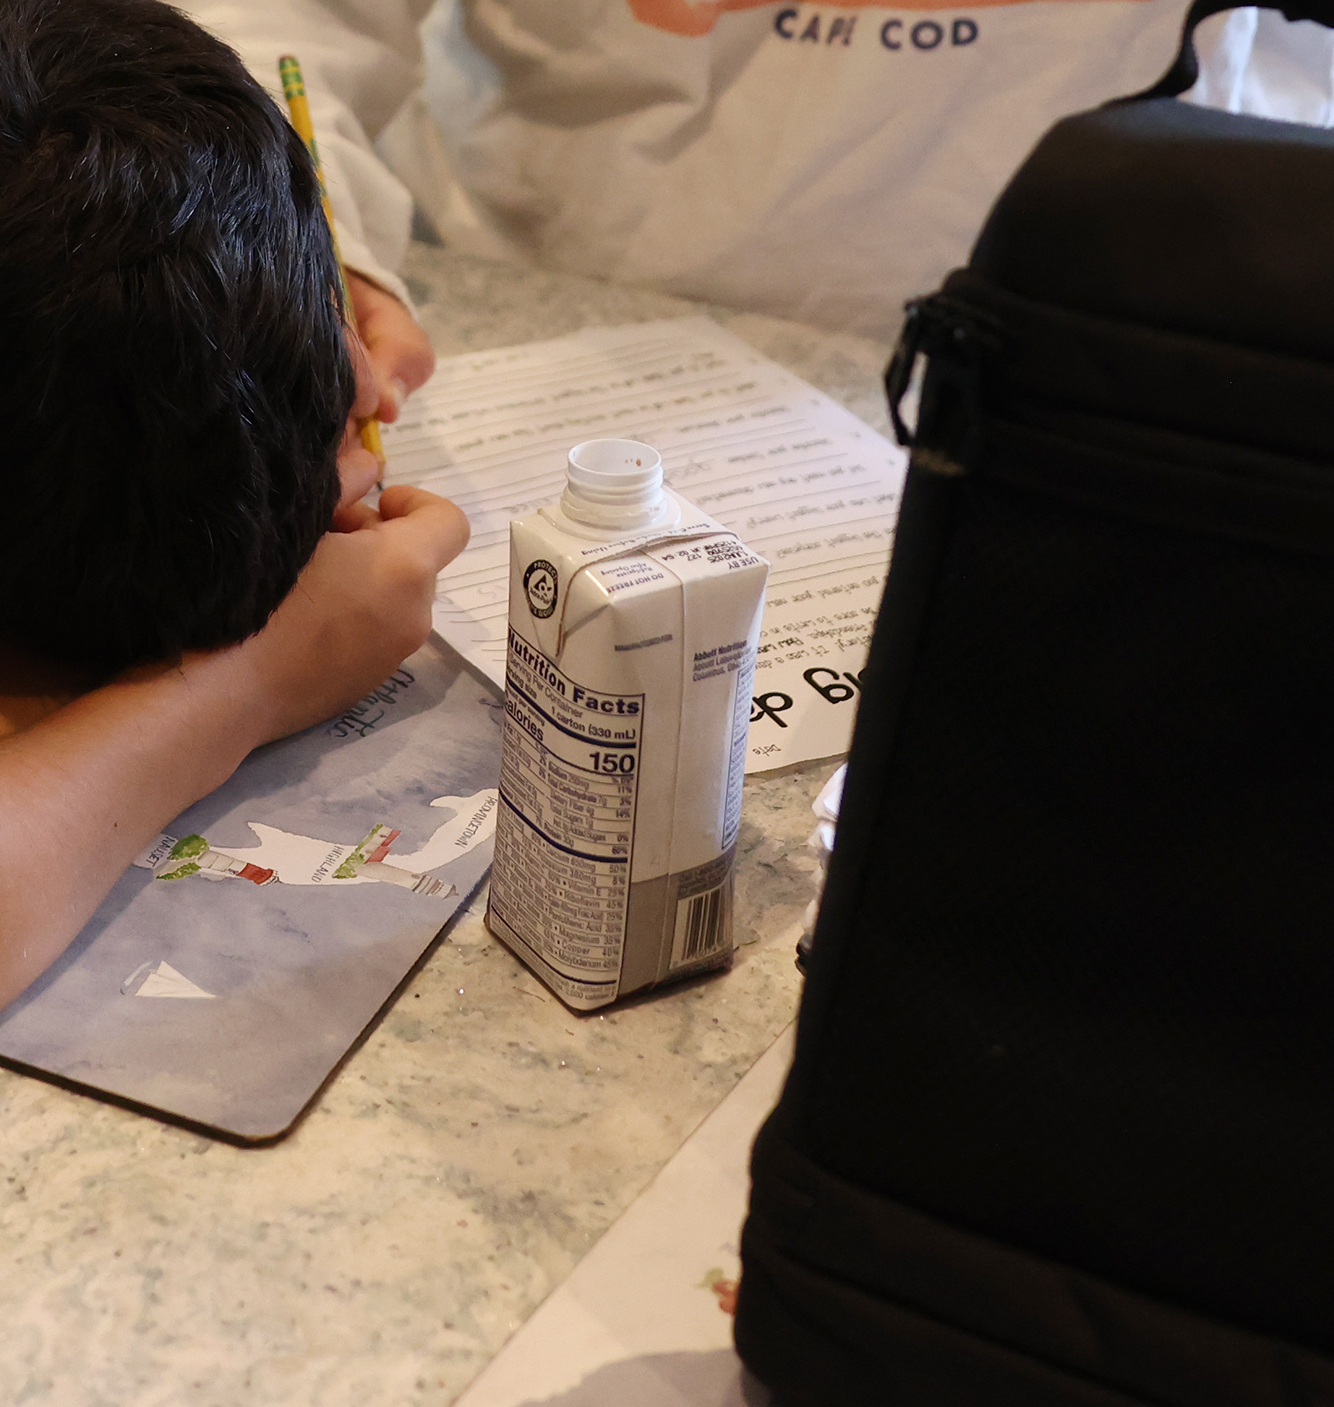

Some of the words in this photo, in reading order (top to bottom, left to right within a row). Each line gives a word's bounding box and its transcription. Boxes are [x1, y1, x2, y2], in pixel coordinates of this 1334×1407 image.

[880, 17, 978, 51] COD
[728, 561, 740, 570] BY
[739, 557, 759, 566] USE
[634, 575, 651, 585] NOT
[651, 573, 664, 581] DO
[545, 687, 583, 719] Container
[572, 686, 640, 714] Facts
[506, 699, 544, 742] alories
[589, 751, 635, 774] 150
[556, 711, 585, 732] carton
[588, 723, 612, 739] (330
[614, 729, 636, 740] mL)
[752, 744, 782, 757] Date
[311, 845, 345, 883] HIGHLAND
